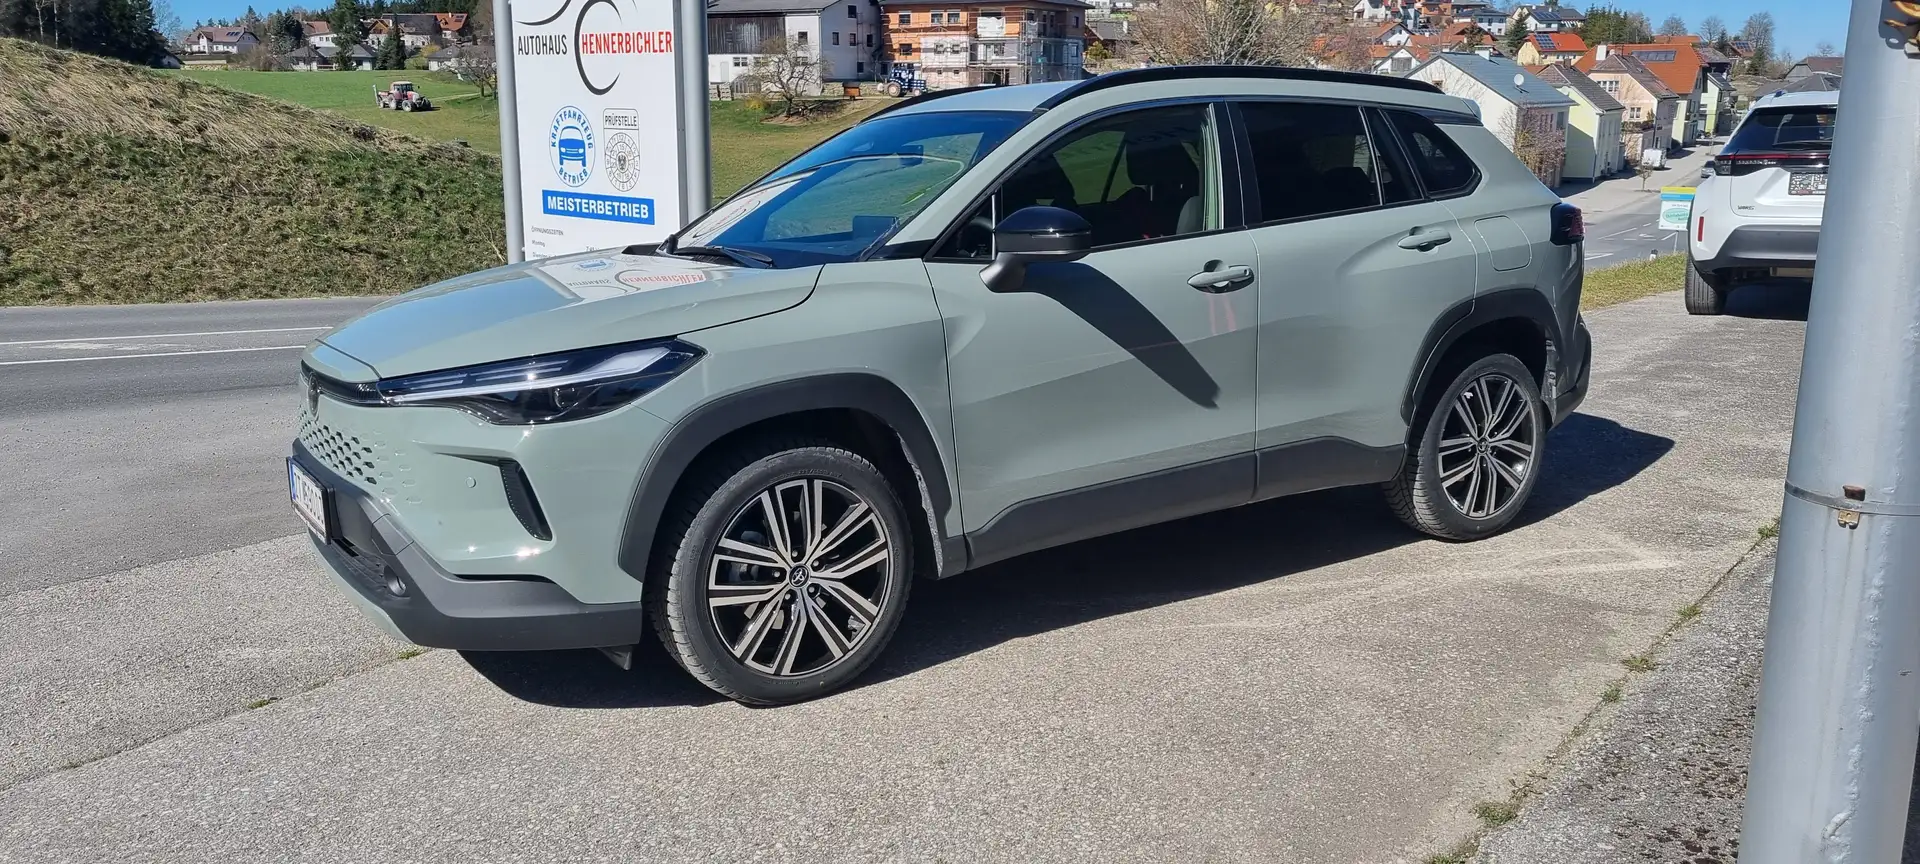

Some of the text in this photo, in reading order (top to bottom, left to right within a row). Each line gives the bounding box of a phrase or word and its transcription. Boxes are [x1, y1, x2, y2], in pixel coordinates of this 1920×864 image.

[518, 31, 673, 56] AUTOHAUS HENNERBICHLER
[551, 110, 593, 148] KRAFTFAHRZEUG
[605, 113, 637, 126] PRÜFSTELLE
[559, 167, 588, 184] BETRIEB
[547, 195, 649, 219] MEISTERBETRIEB
